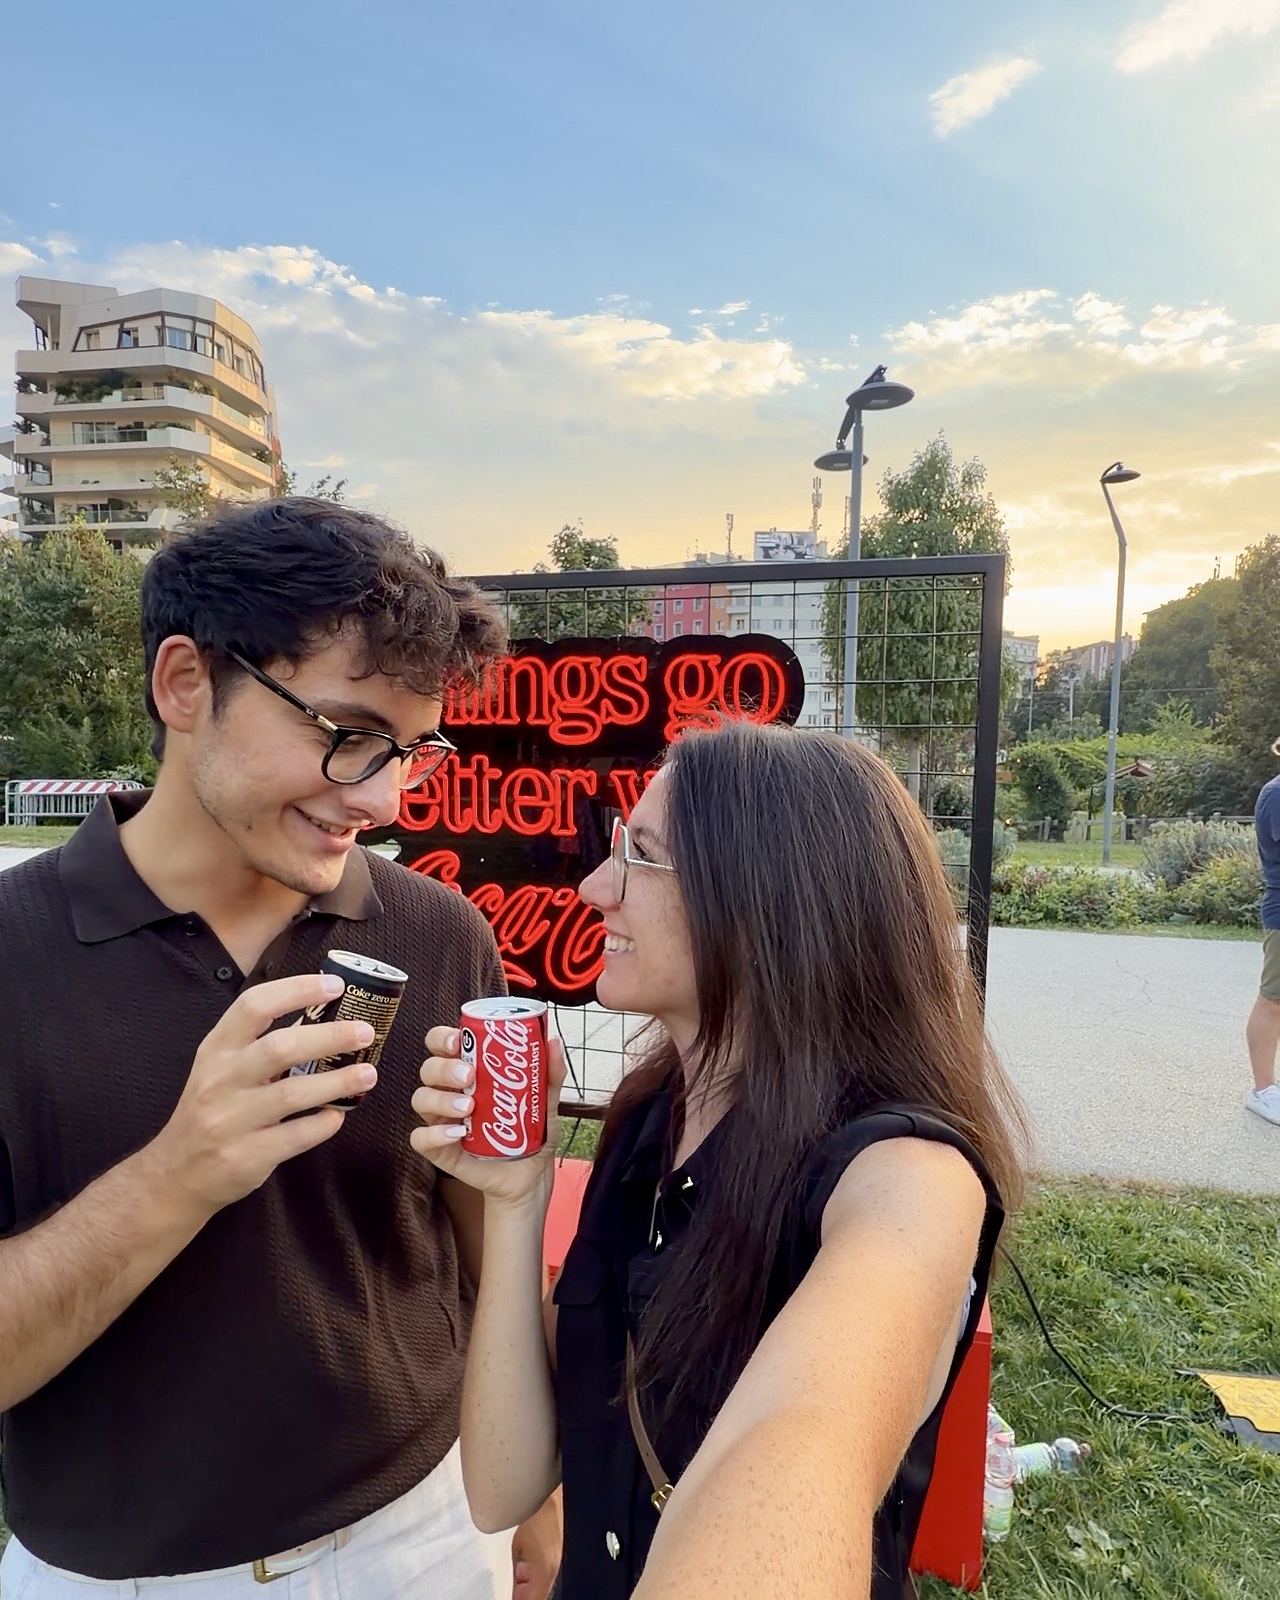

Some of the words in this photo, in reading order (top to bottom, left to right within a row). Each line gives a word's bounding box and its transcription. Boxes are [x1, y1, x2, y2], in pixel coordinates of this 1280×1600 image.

[444, 655, 650, 745] ings
[664, 653, 785, 743] go
[397, 755, 597, 835] etter
[346, 984, 371, 1000] Coke
[370, 993, 390, 1004] zero
[482, 1020, 529, 1156] Coca-Cola
[529, 1040, 540, 1095] zuccheri
[530, 1095, 540, 1123] zero
